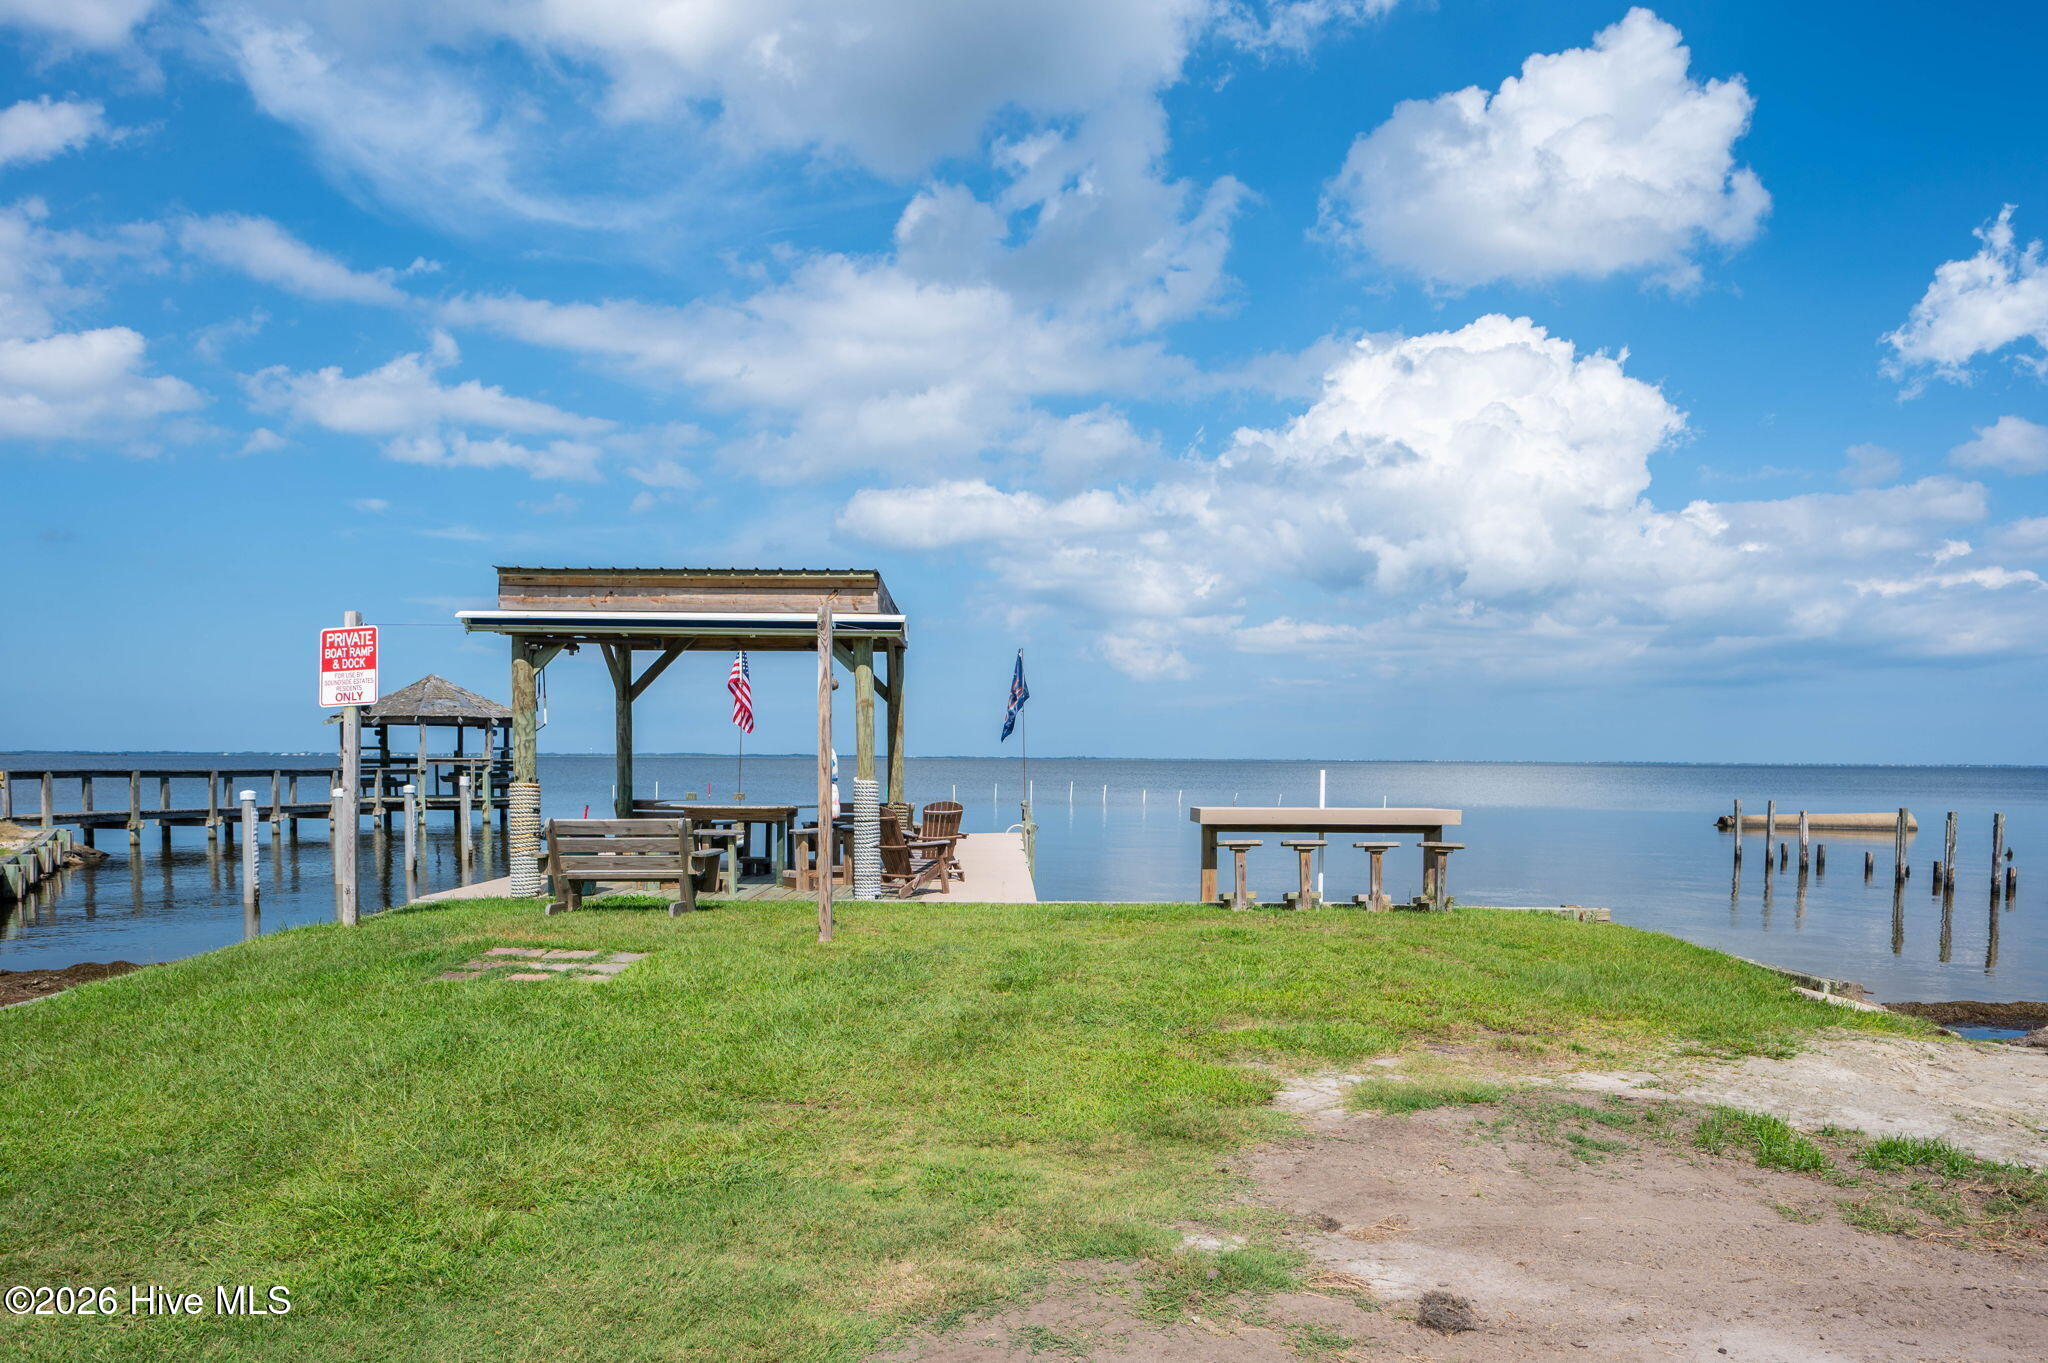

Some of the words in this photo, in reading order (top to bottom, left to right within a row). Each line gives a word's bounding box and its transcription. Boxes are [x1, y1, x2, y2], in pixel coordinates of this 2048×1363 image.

[326, 631, 374, 647] PRIVATE
[325, 648, 347, 659] BOAT
[349, 646, 374, 657] RAMP
[332, 659, 340, 669] &
[342, 658, 366, 669] DOCK
[353, 677, 374, 685] ESTATES
[335, 691, 363, 702] ONLY
